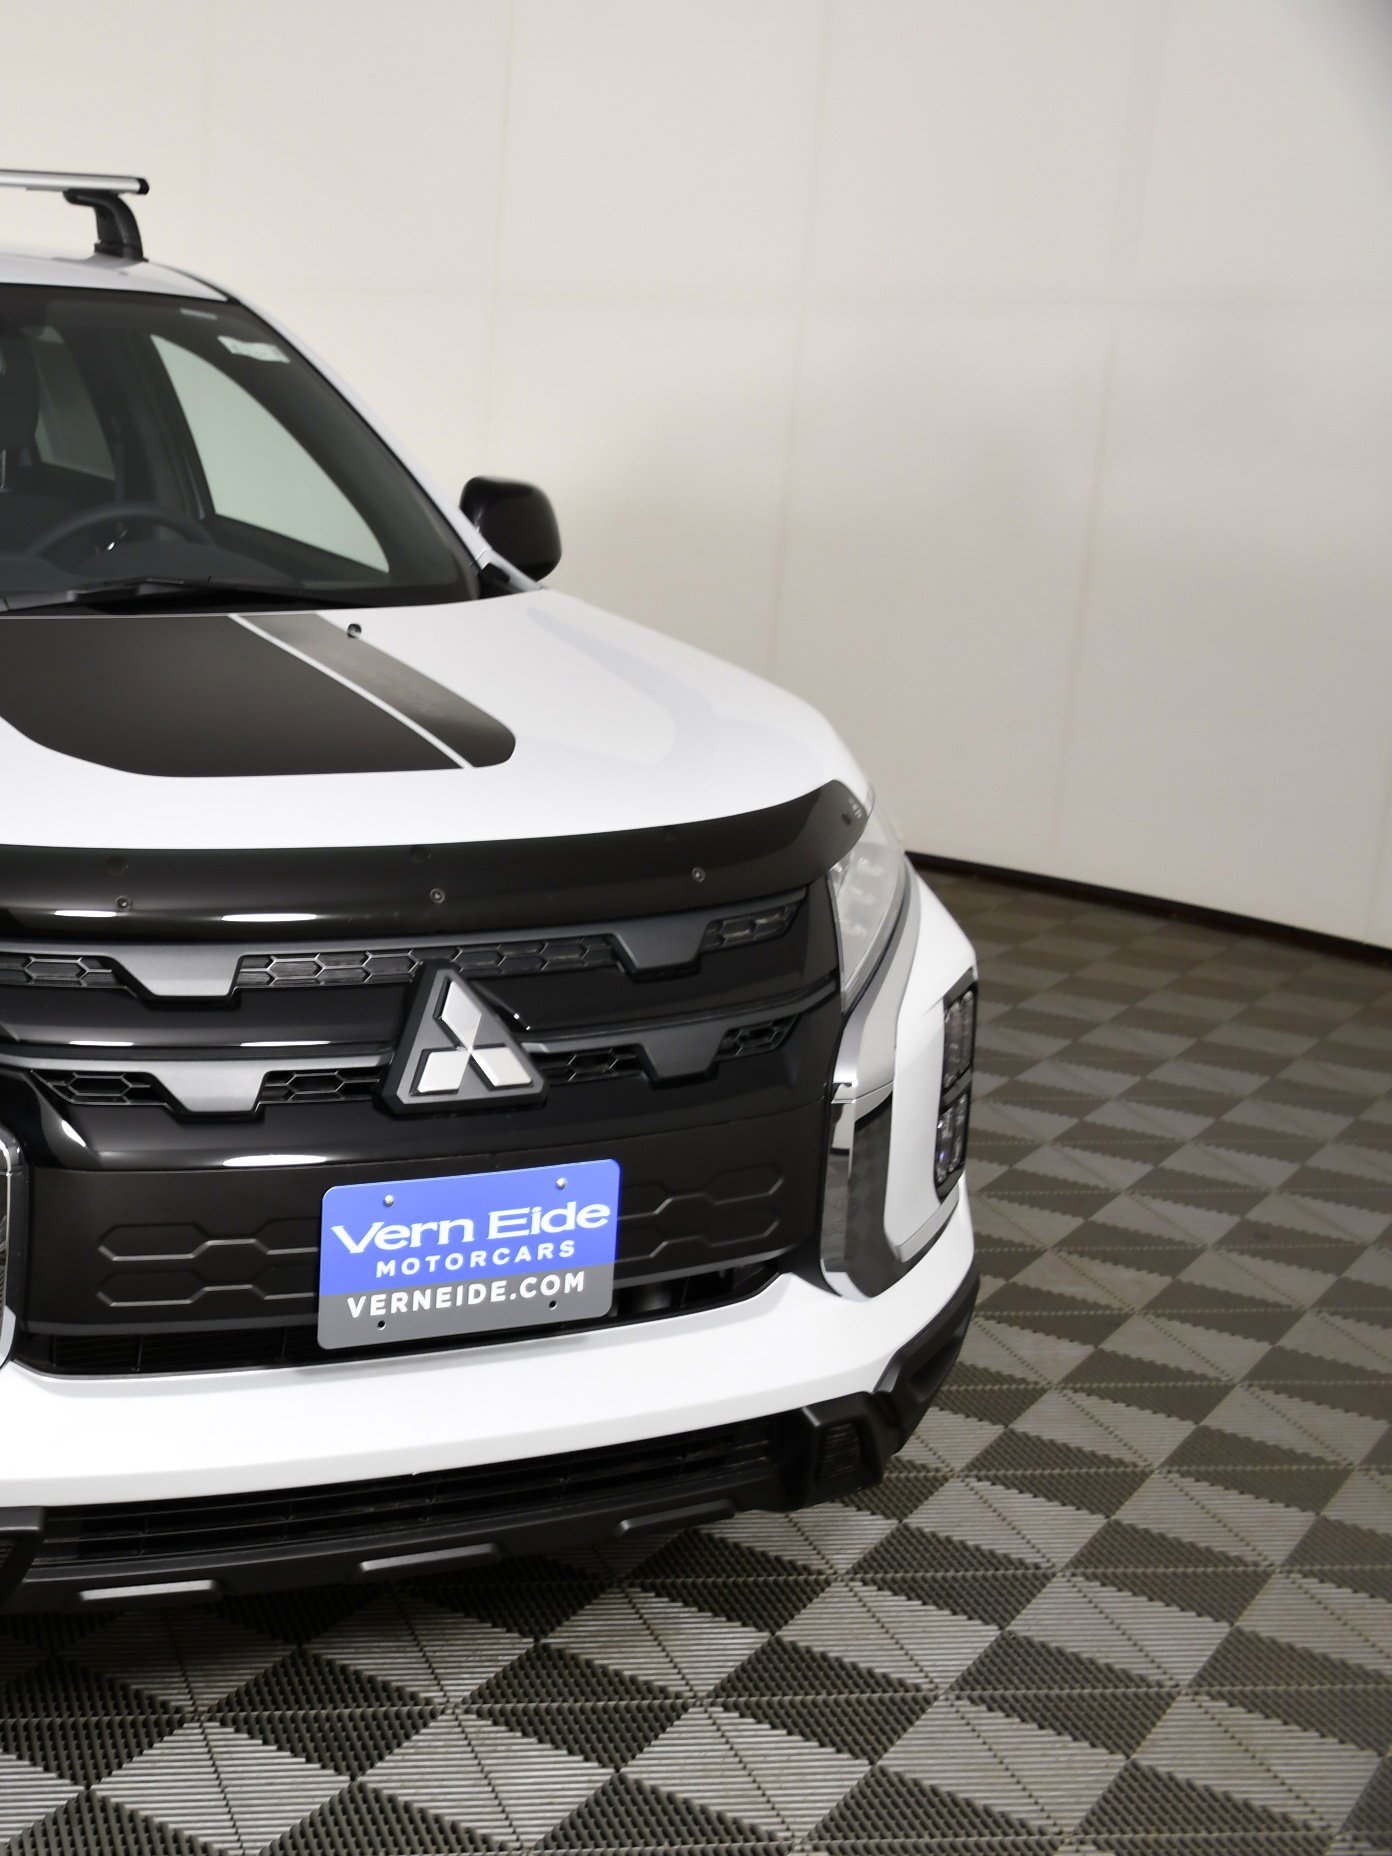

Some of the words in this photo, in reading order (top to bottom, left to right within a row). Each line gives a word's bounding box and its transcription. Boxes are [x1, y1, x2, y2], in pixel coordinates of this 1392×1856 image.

[330, 1218, 475, 1254] Vern
[487, 1201, 611, 1240] Eide
[376, 1240, 576, 1278] MOTORCARS
[347, 1271, 586, 1319] VERNEIDE.COM
